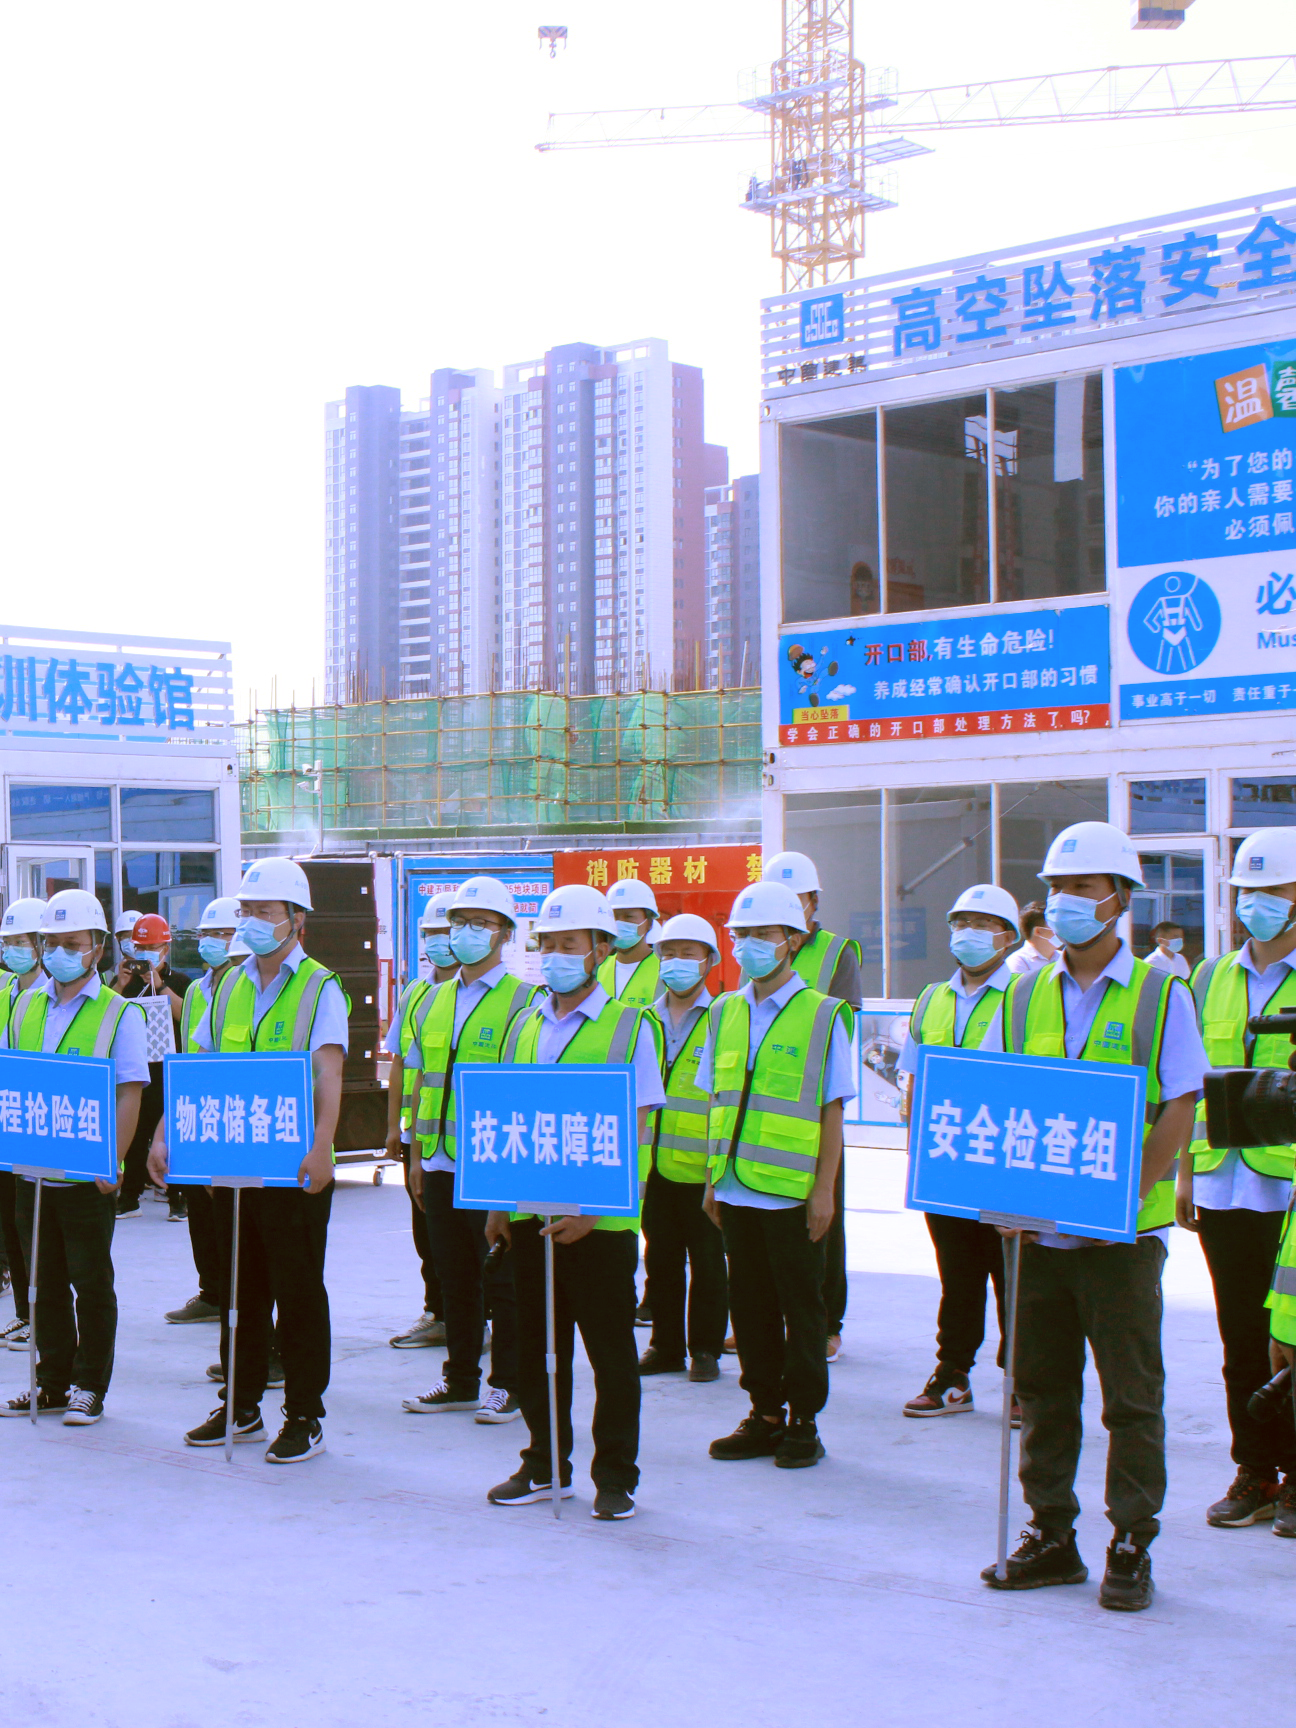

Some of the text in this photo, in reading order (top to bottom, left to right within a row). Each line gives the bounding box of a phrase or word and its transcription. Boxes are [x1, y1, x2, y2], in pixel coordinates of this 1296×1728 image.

[891, 215, 1296, 357] 高空坠落安全
[873, 664, 1099, 700] 养成经常确认开口部的习惯
[1131, 689, 1217, 709] 事业高于一切
[800, 708, 840, 721] 当心坠落
[585, 855, 708, 887] 消防器材
[175, 1095, 301, 1143] 物资储备组
[471, 1110, 622, 1167] 技术保障组
[927, 1099, 1117, 1181] 安全检查组
